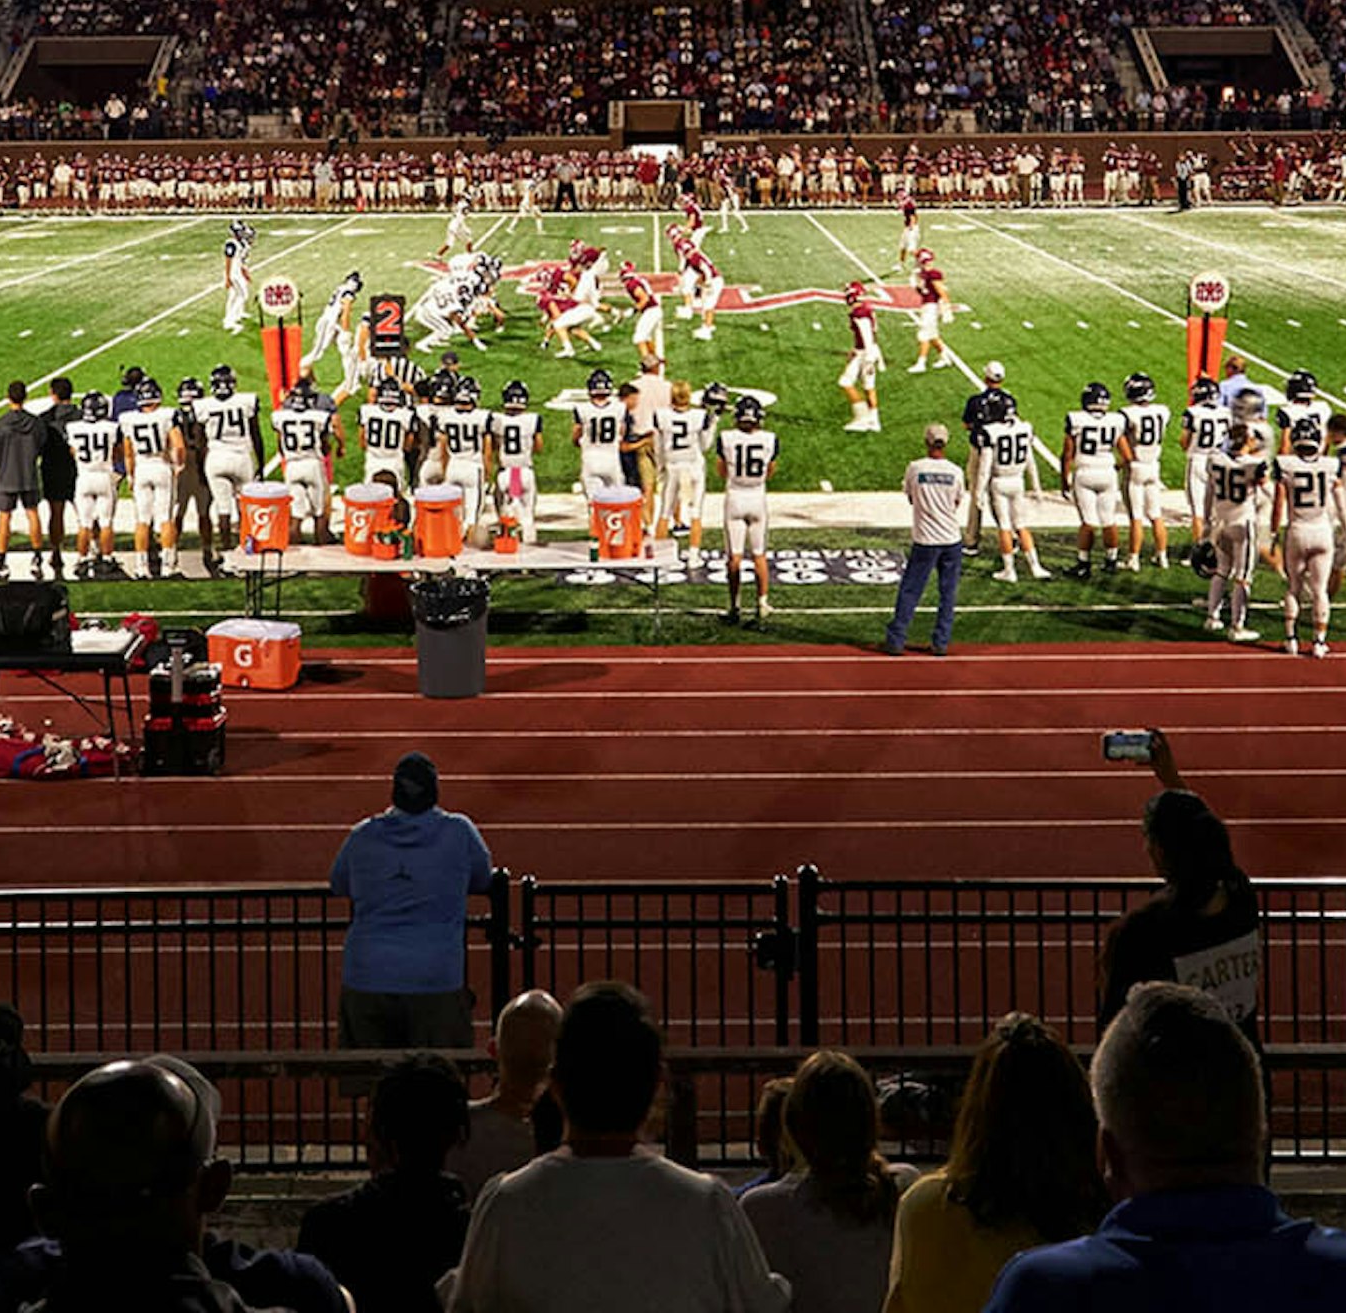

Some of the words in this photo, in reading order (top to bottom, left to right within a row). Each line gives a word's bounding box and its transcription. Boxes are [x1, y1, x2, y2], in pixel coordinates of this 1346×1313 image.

[375, 300, 401, 335] 2
[134, 422, 162, 454] 51
[209, 408, 245, 440] 74
[283, 420, 315, 450] 63
[368, 417, 401, 449] 80
[445, 422, 479, 452] 84
[504, 424, 522, 454] 8
[590, 416, 616, 443] 18
[672, 419, 690, 449] 2
[1140, 414, 1164, 445] 81
[73, 432, 109, 462] 34
[997, 433, 1028, 465] 86
[1081, 426, 1116, 455] 64
[734, 444, 764, 477] 16
[1211, 463, 1247, 504] 36
[1293, 471, 1326, 507] 21
[233, 644, 253, 668] G
